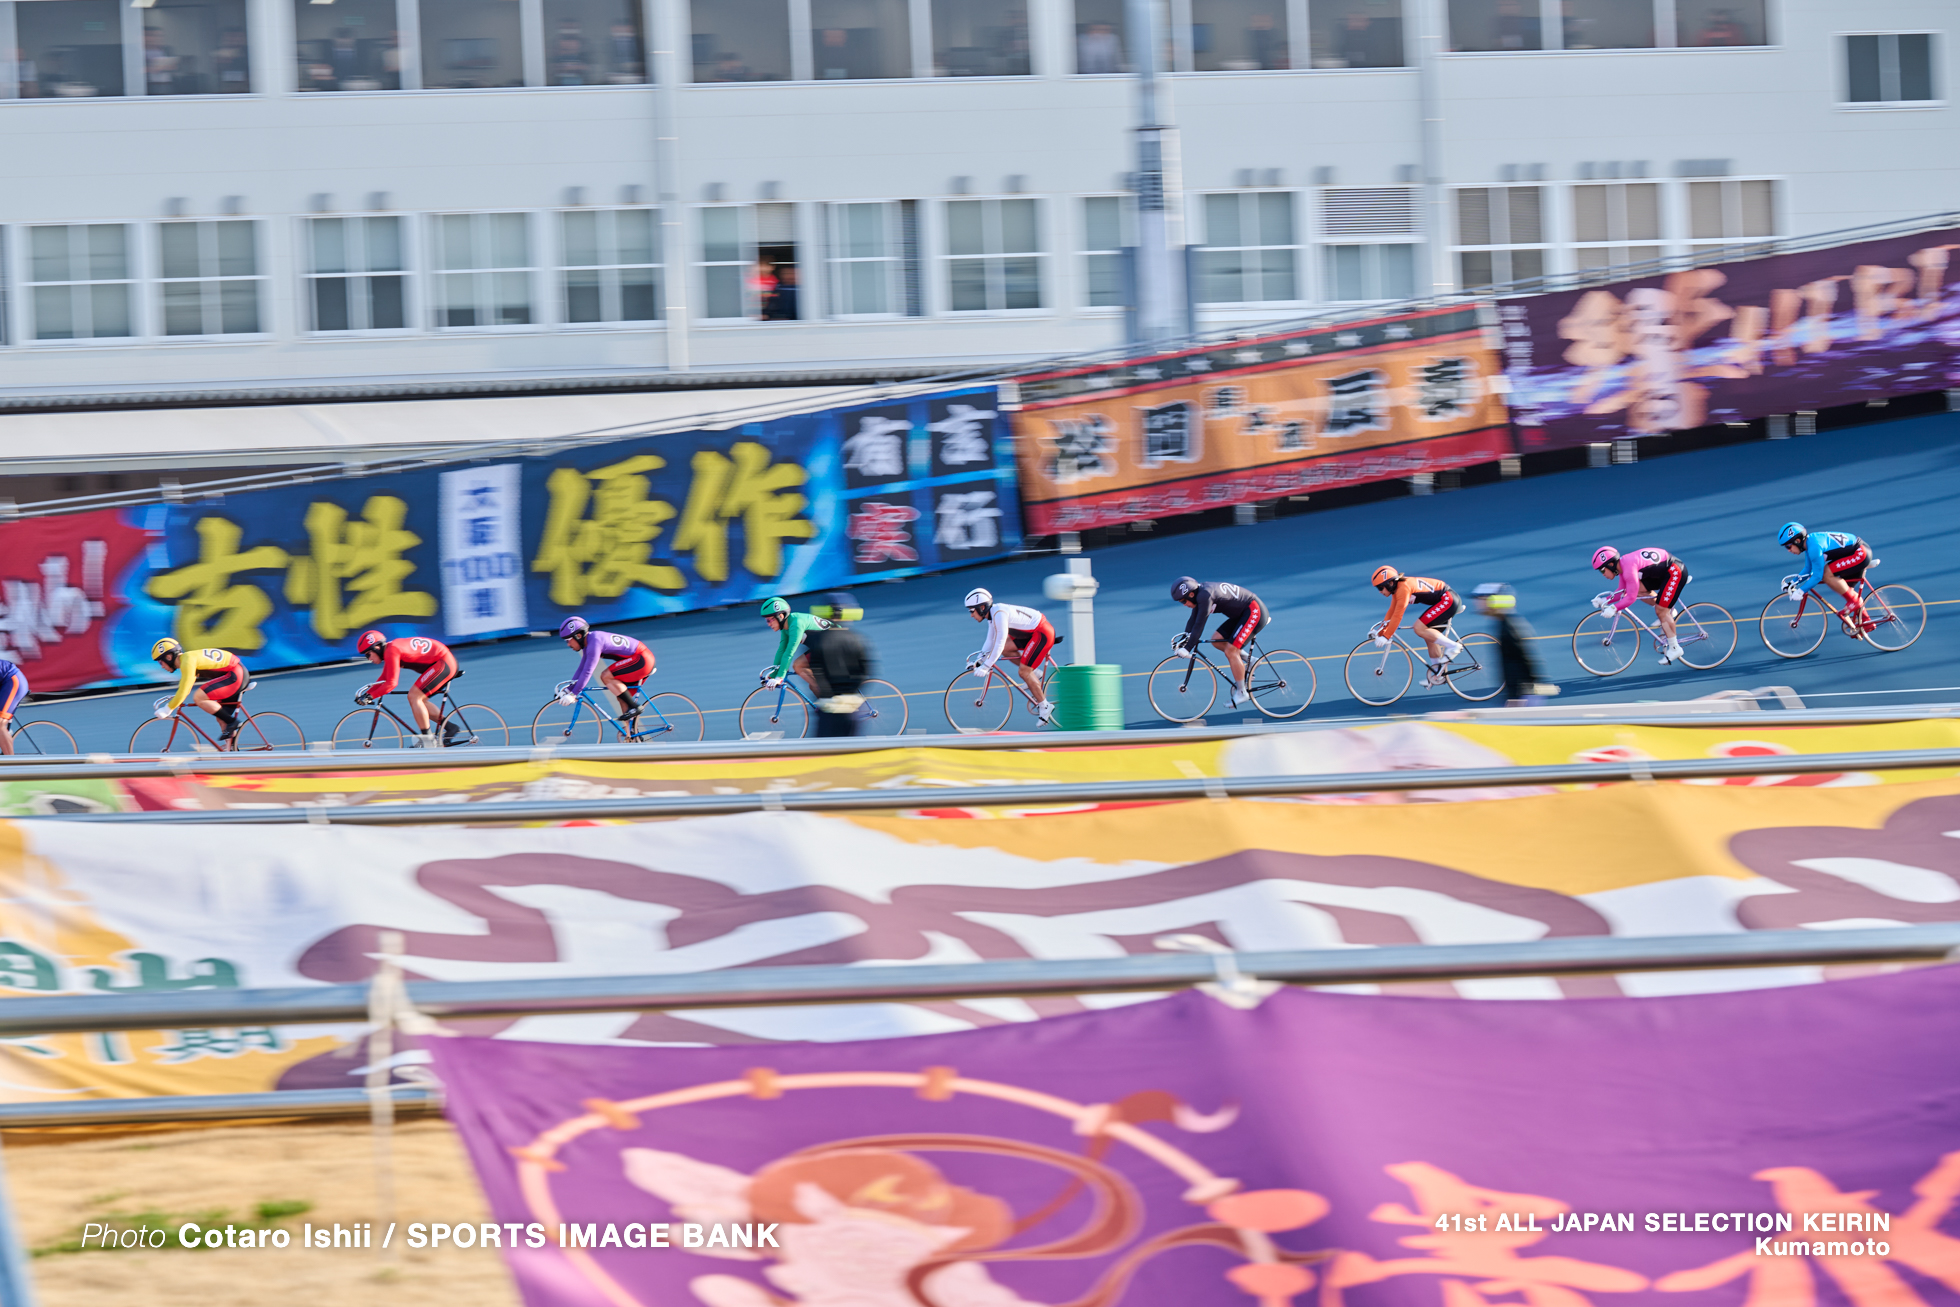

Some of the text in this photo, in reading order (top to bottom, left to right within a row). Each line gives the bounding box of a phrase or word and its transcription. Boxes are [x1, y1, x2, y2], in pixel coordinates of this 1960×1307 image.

[1788, 527, 1795, 538] 4
[146, 494, 440, 652] 古性
[531, 441, 818, 607] 優作
[1828, 532, 1849, 549] 4
[1600, 552, 1607, 563] 8
[1640, 550, 1661, 565] 8
[1381, 570, 1388, 581] 7
[1179, 583, 1189, 596] 2
[1219, 582, 1240, 599] 2
[1417, 578, 1435, 594] 7
[773, 601, 781, 612] 6
[1015, 608, 1033, 620] 1
[568, 621, 576, 634] 9
[813, 615, 833, 631] 6
[366, 633, 376, 645] 3
[410, 637, 433, 654] 3
[610, 633, 631, 649] 9
[157, 641, 166, 654] 5
[202, 647, 224, 663] 5
